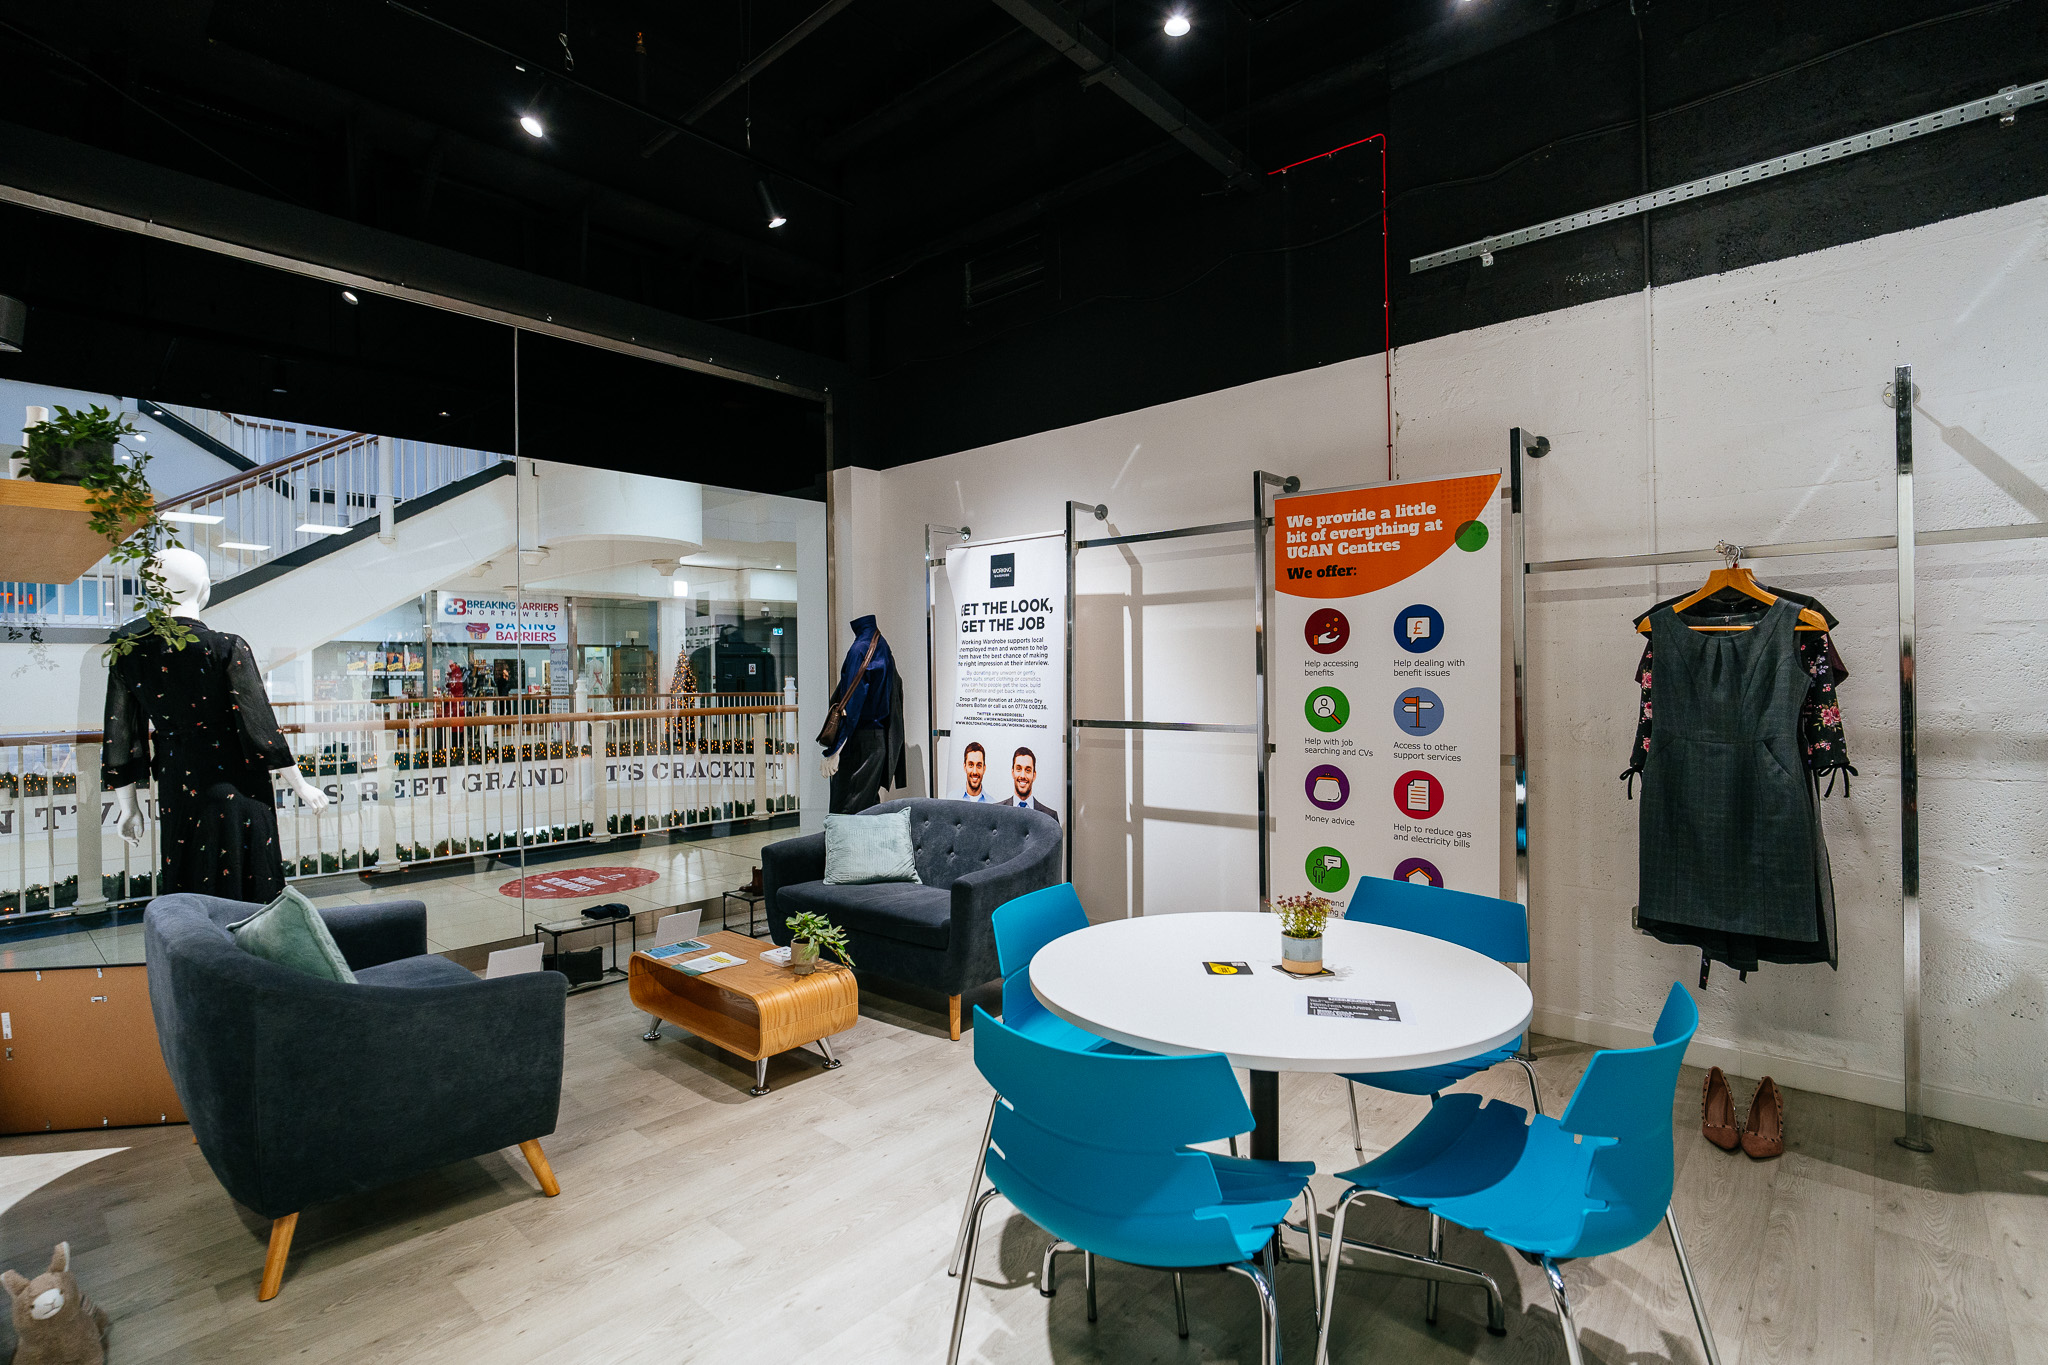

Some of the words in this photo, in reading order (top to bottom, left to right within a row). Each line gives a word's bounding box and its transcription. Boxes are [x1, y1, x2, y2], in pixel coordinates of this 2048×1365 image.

[1286, 515, 1312, 528] We
[1316, 508, 1376, 529] provide
[1380, 509, 1391, 519] a
[1395, 502, 1436, 518] little
[1286, 531, 1307, 543] bit
[1311, 528, 1327, 542] of
[1330, 521, 1420, 540] everything
[1424, 519, 1443, 532] at
[1287, 543, 1333, 559] UCAN
[1338, 541, 1401, 555] Centres
[1287, 567, 1312, 580] We
[1316, 564, 1357, 578] offer:
[467, 600, 516, 610] BREAKING
[982, 601, 1008, 615] THE
[1011, 598, 1053, 614] LOOK,
[961, 619, 986, 633] GET
[989, 618, 1014, 632] THE
[1017, 616, 1045, 631] JOB
[496, 631, 557, 642] BARRIERS
[1007, 637, 1031, 645] supports
[1036, 644, 1048, 652] help
[1304, 660, 1321, 668] Help
[1323, 660, 1359, 668] accessing
[1393, 659, 1412, 668] Help
[1414, 659, 1445, 668] dealing
[1447, 659, 1465, 667] with
[1304, 669, 1334, 677] benefits
[1393, 669, 1422, 677] benefit
[1424, 669, 1451, 677] issues
[1304, 737, 1322, 746] Help
[1323, 738, 1340, 746] with
[1341, 739, 1354, 748] job
[1393, 741, 1421, 750] Access
[1423, 743, 1432, 751] to
[1434, 743, 1458, 752] other
[1304, 747, 1341, 756] searching
[1342, 748, 1356, 756] and
[1358, 749, 1374, 757] CVs
[1393, 751, 1425, 761] support
[1427, 753, 1462, 762] services
[462, 767, 568, 793] GRAND
[1304, 814, 1330, 824] Money
[1331, 817, 1355, 826] advice
[1393, 823, 1412, 833] Help
[1414, 825, 1423, 833] to
[1425, 827, 1454, 837] reduce
[1456, 831, 1472, 840] gas
[1393, 833, 1409, 842] and
[1411, 835, 1451, 848] electricity
[1453, 839, 1471, 848] bills
